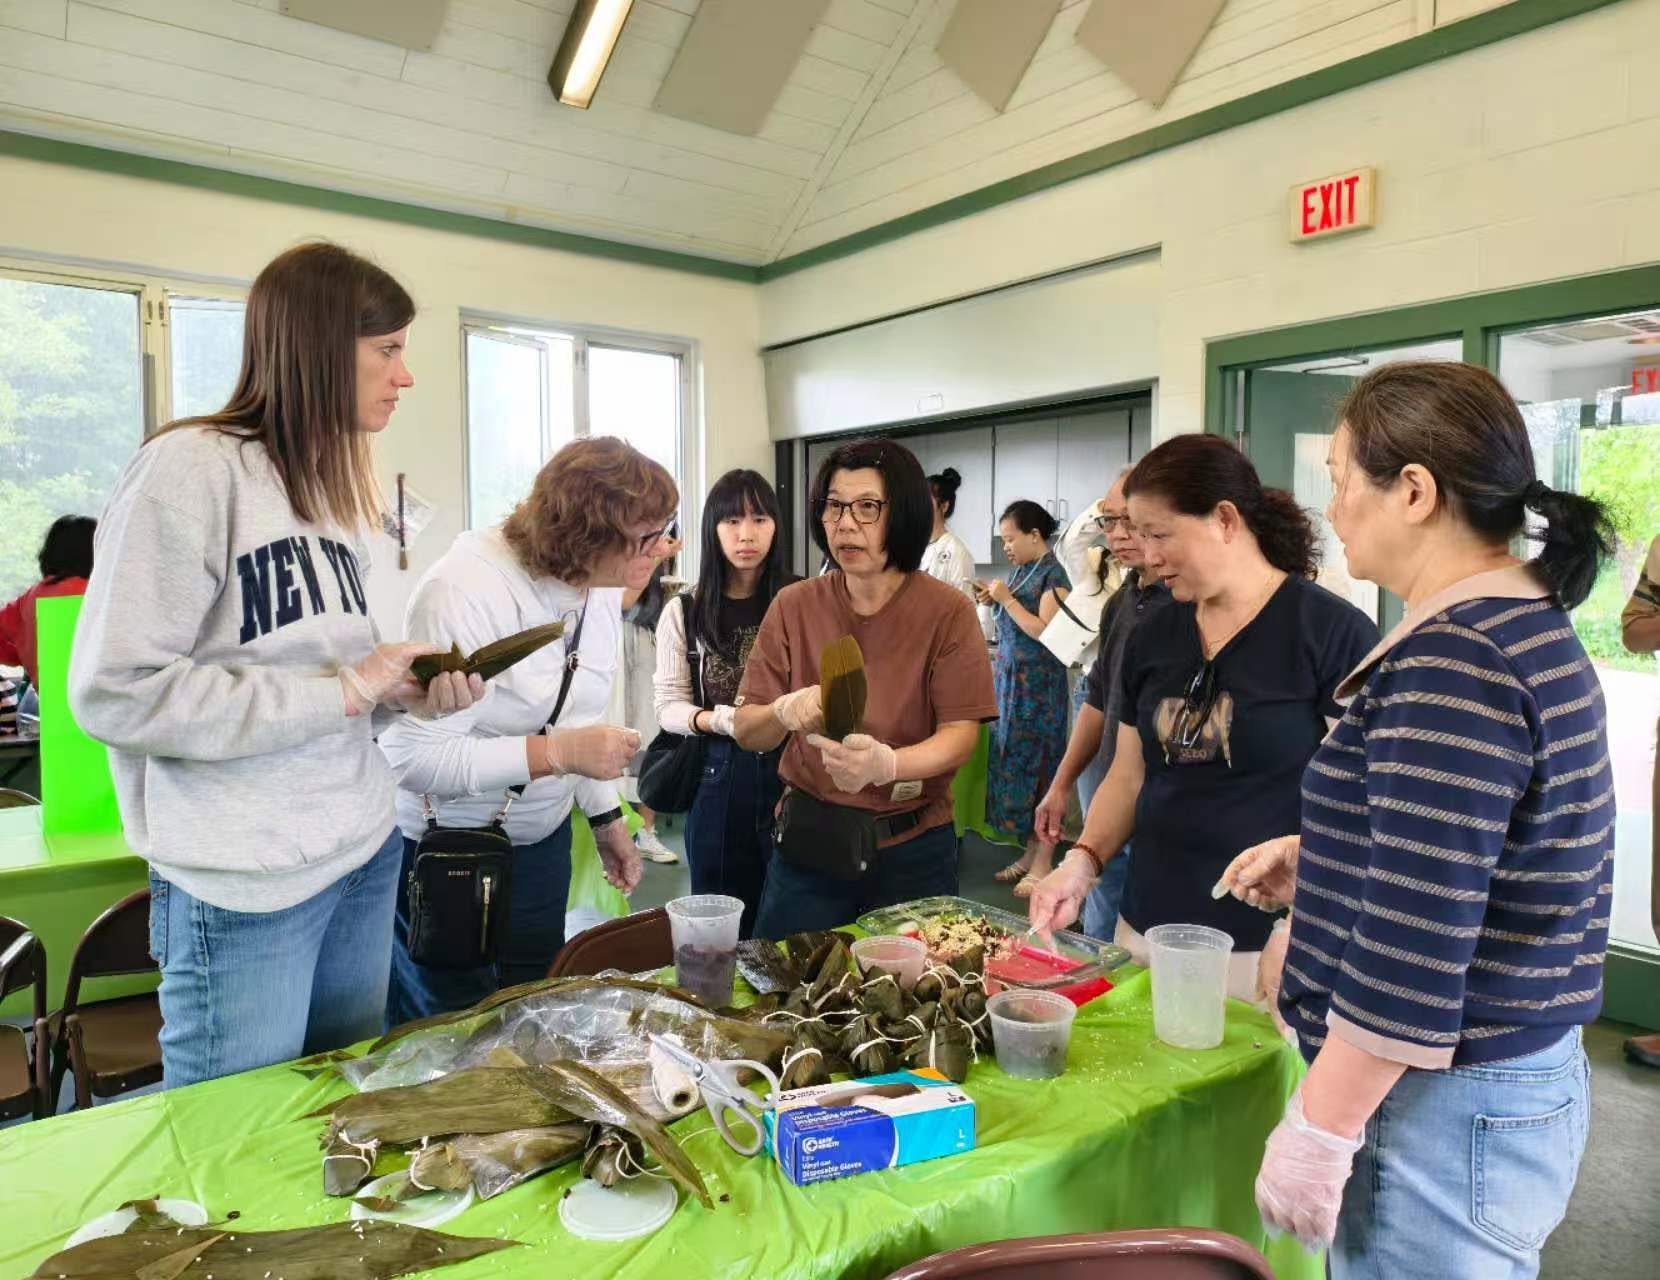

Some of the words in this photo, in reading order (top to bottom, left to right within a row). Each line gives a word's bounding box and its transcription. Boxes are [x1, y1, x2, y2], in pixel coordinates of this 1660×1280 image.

[1303, 175, 1359, 235] EXIT
[237, 536, 326, 645] NEW
[318, 536, 367, 616] YO
[959, 1128, 966, 1139] L
[839, 1161, 862, 1171] Gloves
